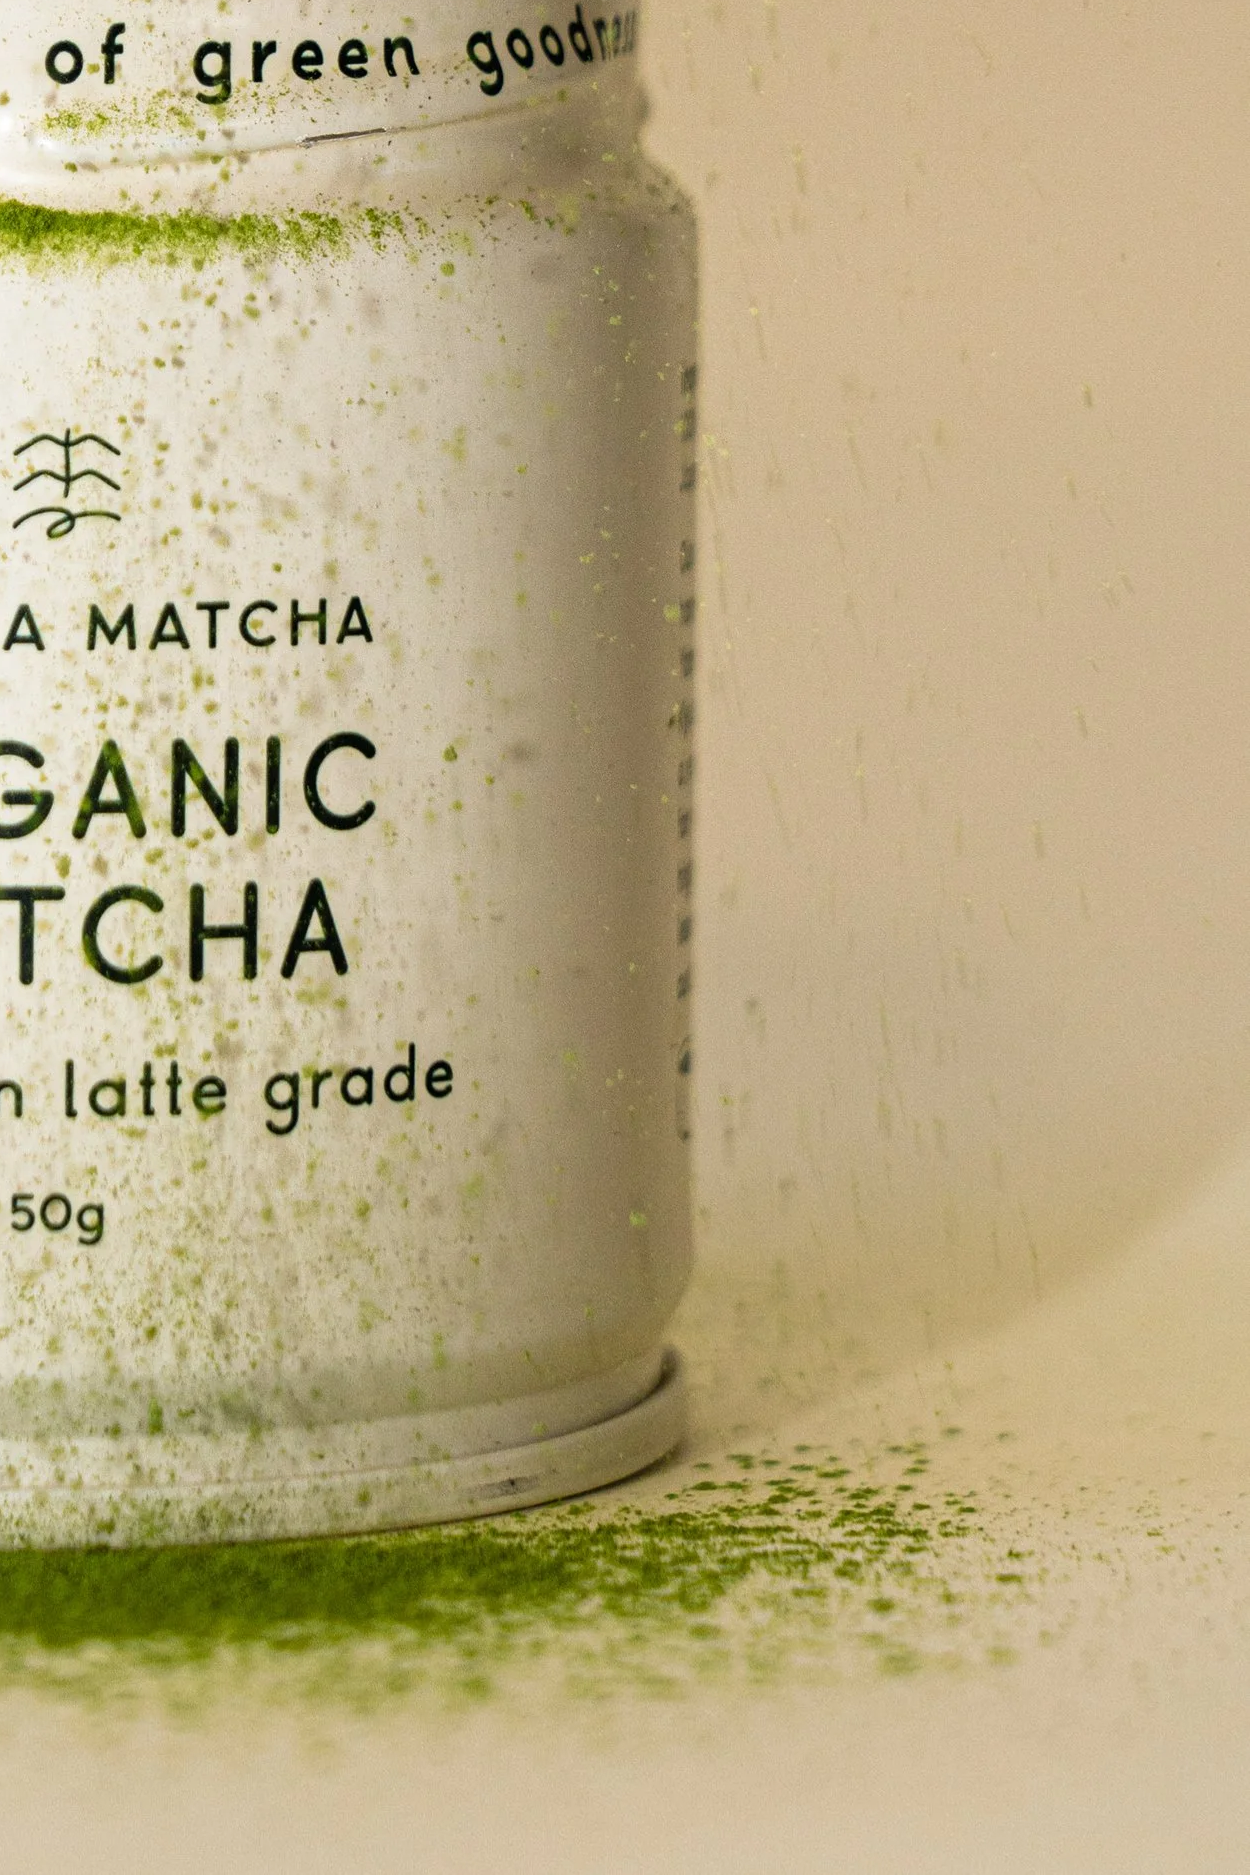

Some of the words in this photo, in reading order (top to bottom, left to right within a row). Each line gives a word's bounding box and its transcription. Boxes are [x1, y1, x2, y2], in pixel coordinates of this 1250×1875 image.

[44, 23, 126, 85] of
[193, 35, 421, 106] green
[86, 596, 373, 651] MATCHA
[64, 1059, 227, 1118] latte
[265, 1042, 454, 1135] grade
[10, 1191, 106, 1246] 50g
